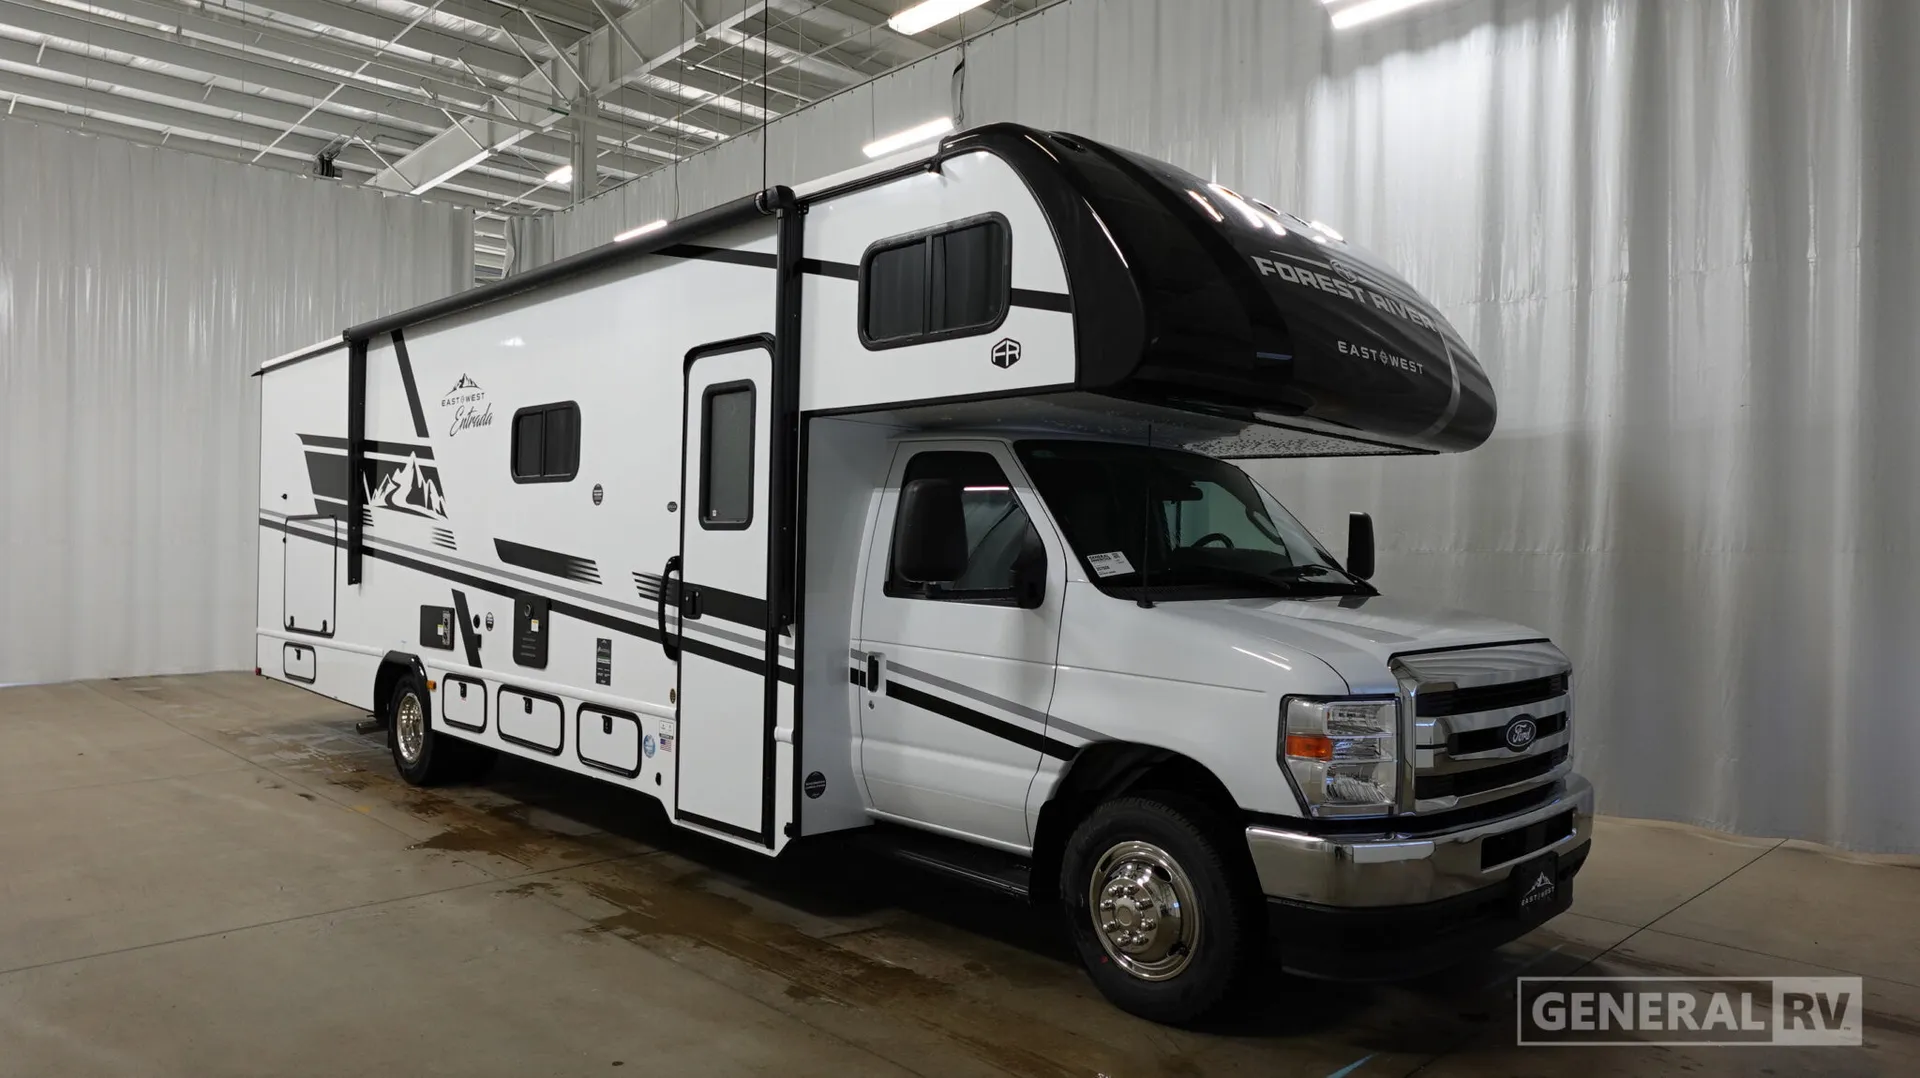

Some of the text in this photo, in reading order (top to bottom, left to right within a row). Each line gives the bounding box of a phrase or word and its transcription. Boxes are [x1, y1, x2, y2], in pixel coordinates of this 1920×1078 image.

[1251, 256, 1364, 304] FOREST
[1369, 292, 1437, 332] RIVER
[1337, 340, 1425, 375] EAST WEST
[450, 402, 494, 437] Entrada
[1512, 723, 1532, 743] Ford
